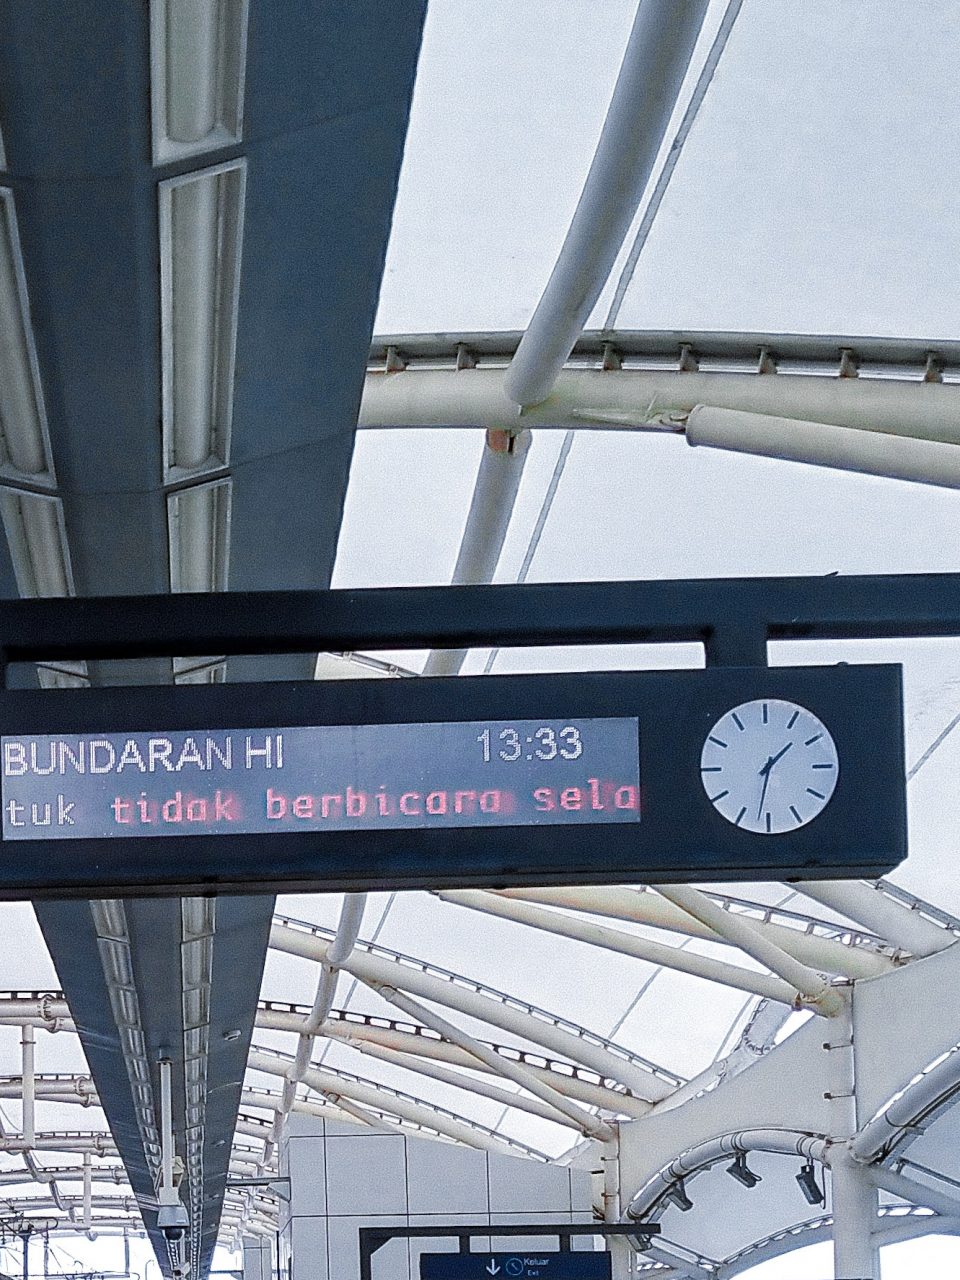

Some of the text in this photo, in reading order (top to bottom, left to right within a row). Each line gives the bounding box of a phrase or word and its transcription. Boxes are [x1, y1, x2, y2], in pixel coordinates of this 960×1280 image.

[4, 734, 283, 776] BUNDARAN HI
[476, 726, 584, 762] 13:33
[5, 777, 638, 826] tuk tidak berbicara sela
